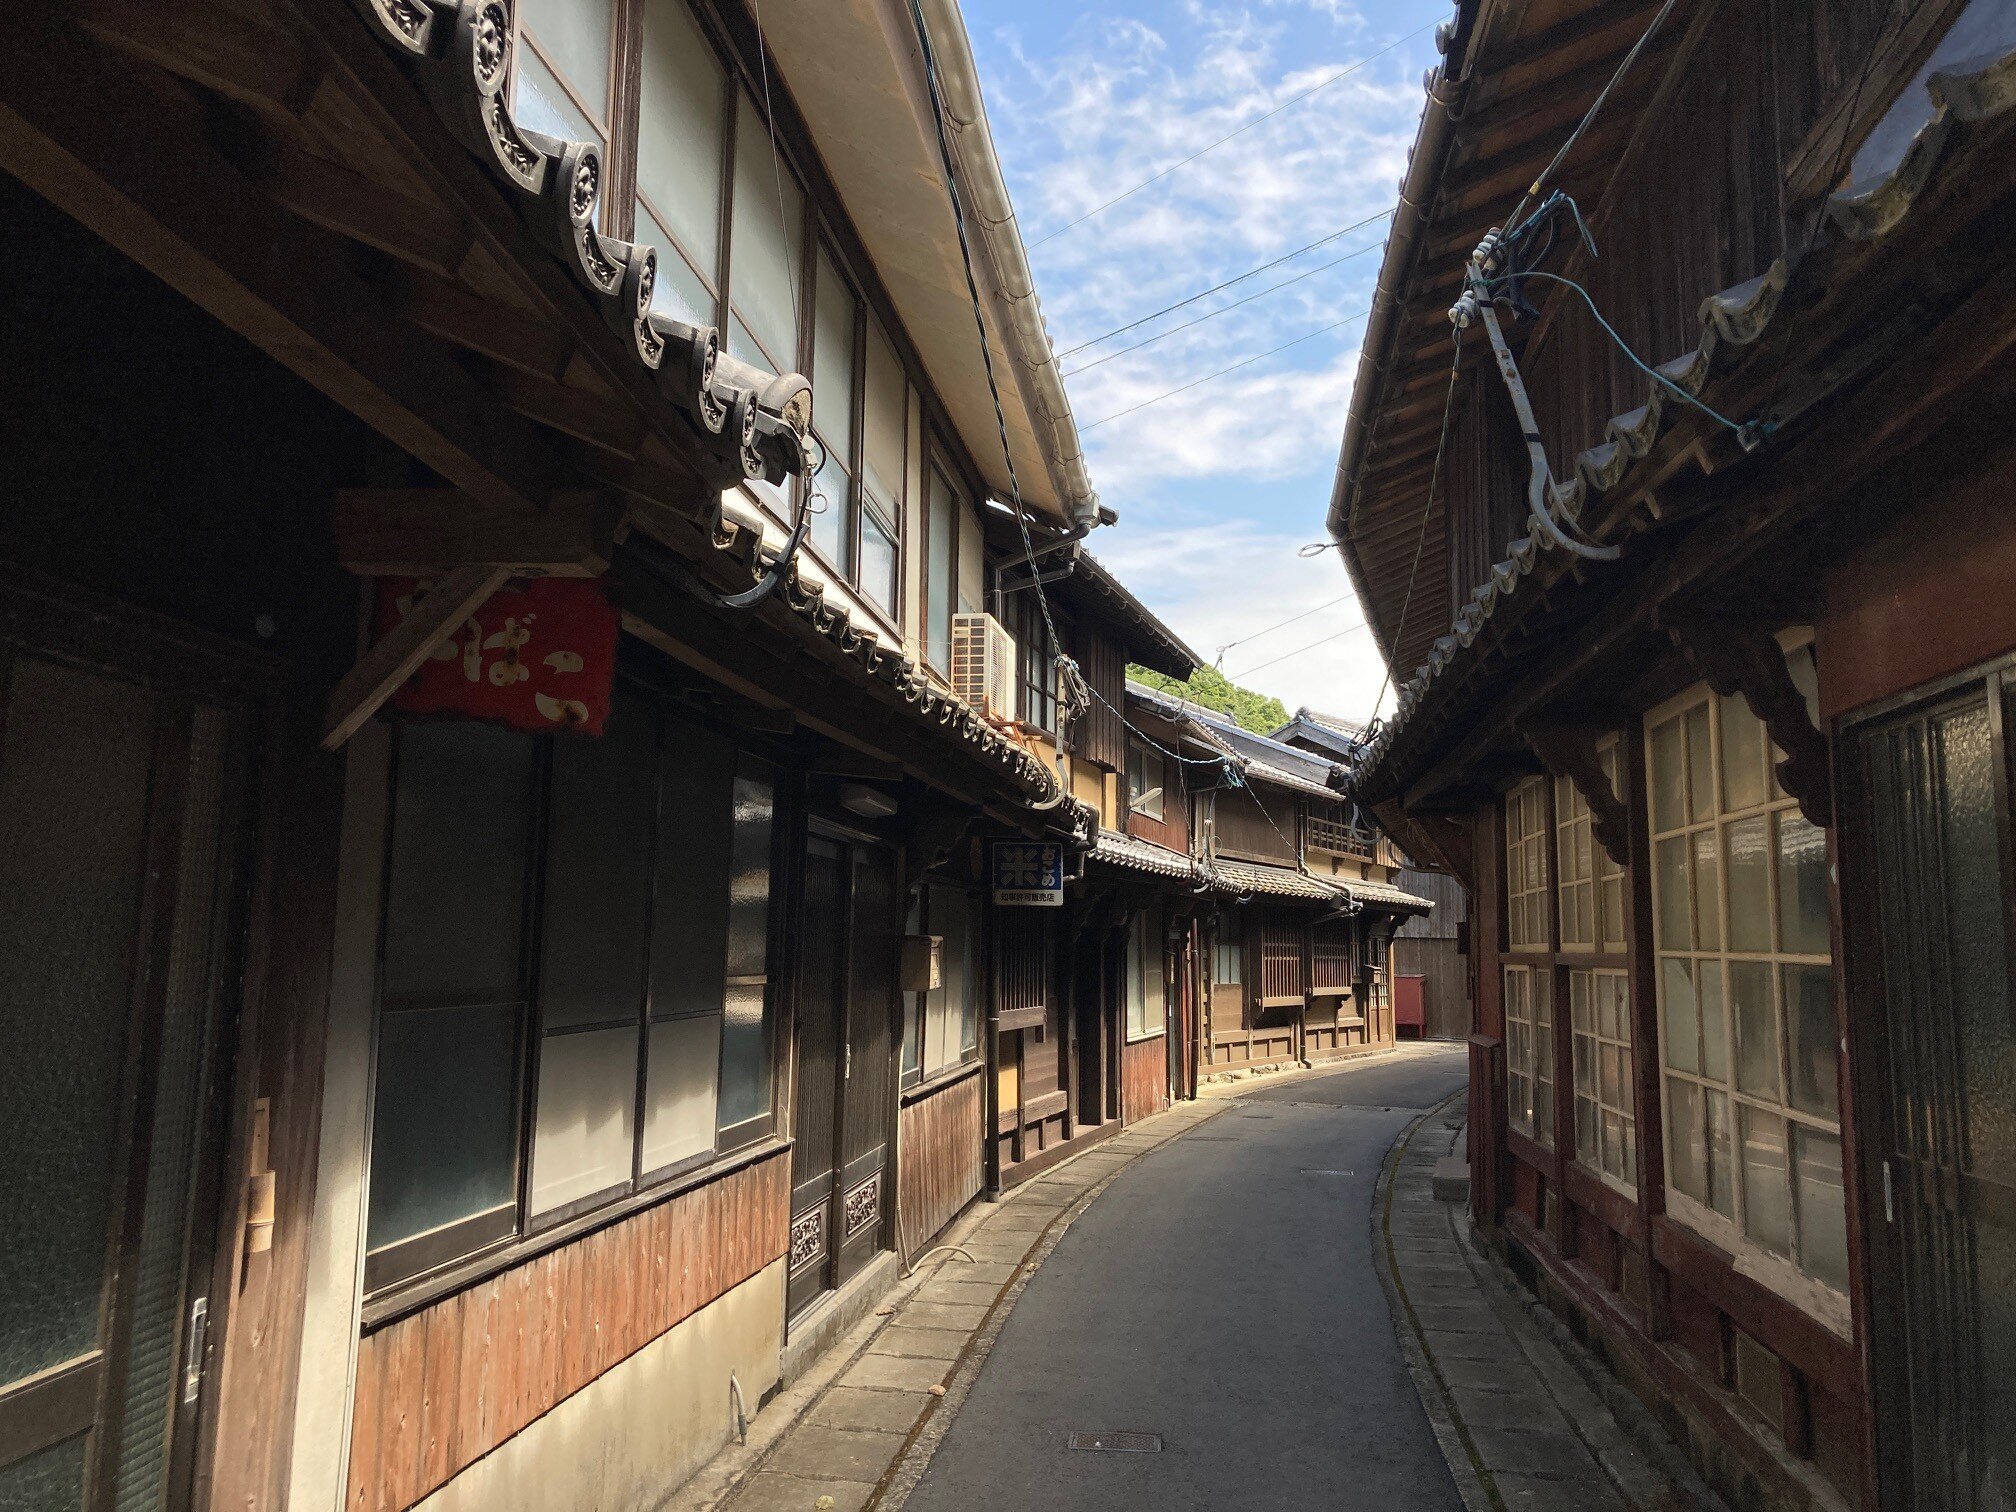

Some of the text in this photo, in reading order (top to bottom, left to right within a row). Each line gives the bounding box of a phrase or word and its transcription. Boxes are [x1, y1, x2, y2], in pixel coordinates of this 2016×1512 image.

[1001, 847, 1038, 886] 米
[1041, 847, 1056, 887] おこめ
